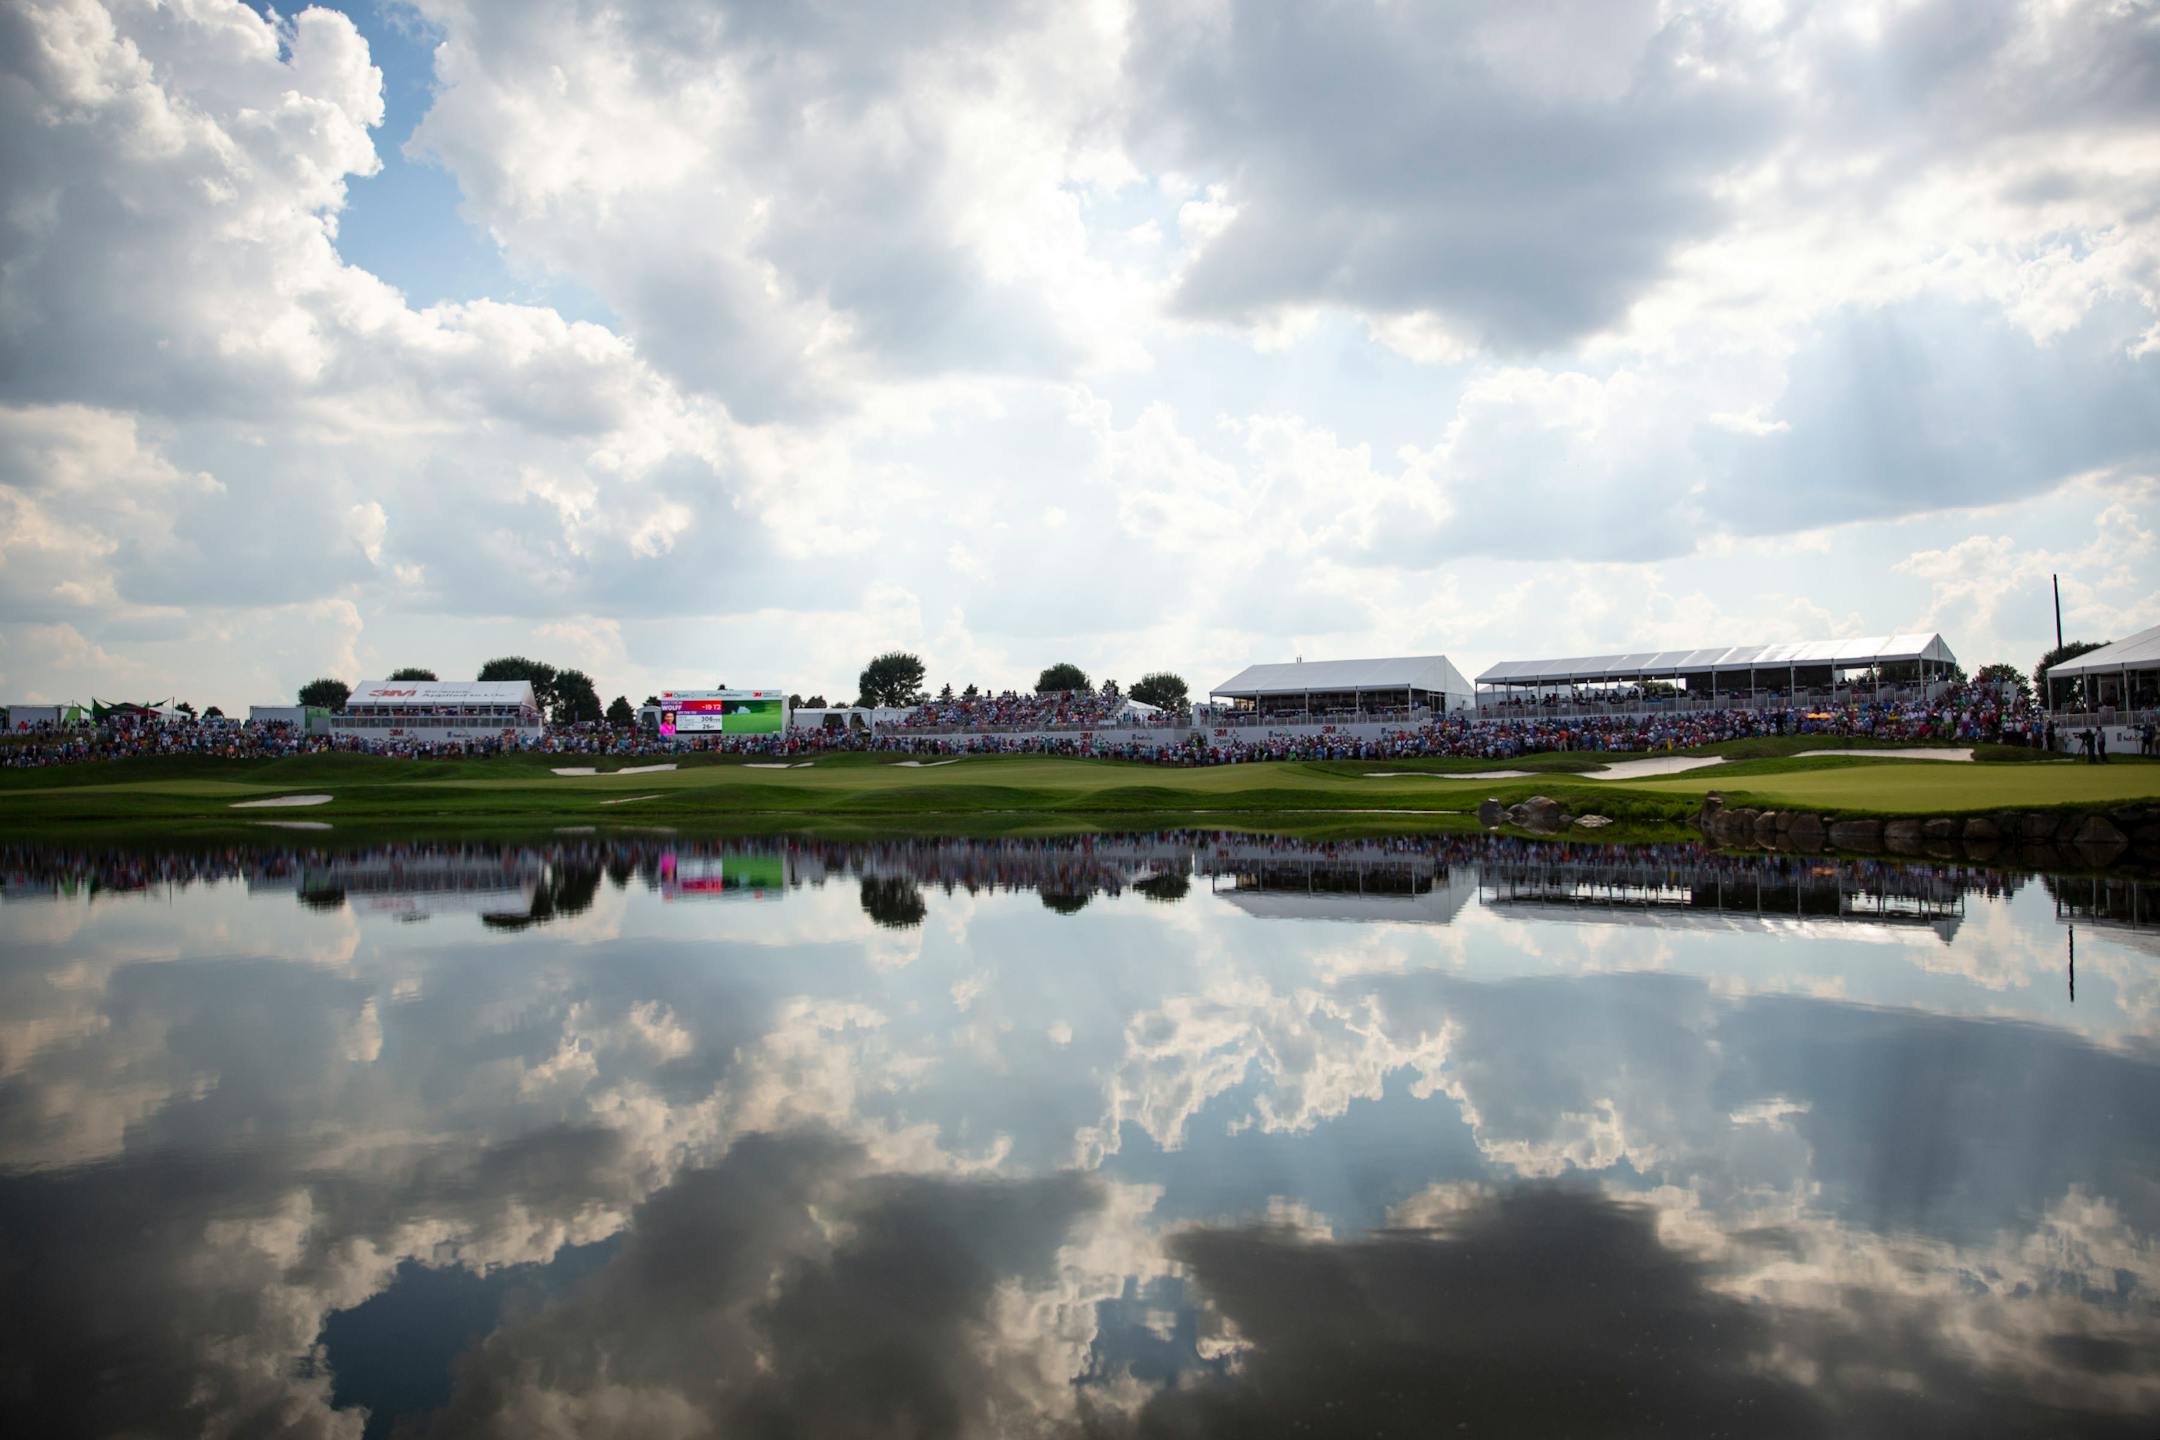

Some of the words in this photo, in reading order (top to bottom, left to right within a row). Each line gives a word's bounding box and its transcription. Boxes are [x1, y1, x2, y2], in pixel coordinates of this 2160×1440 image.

[389, 729, 404, 737] 3M
[1214, 729, 1228, 737] 3M
[1322, 726, 1336, 734] 3M
